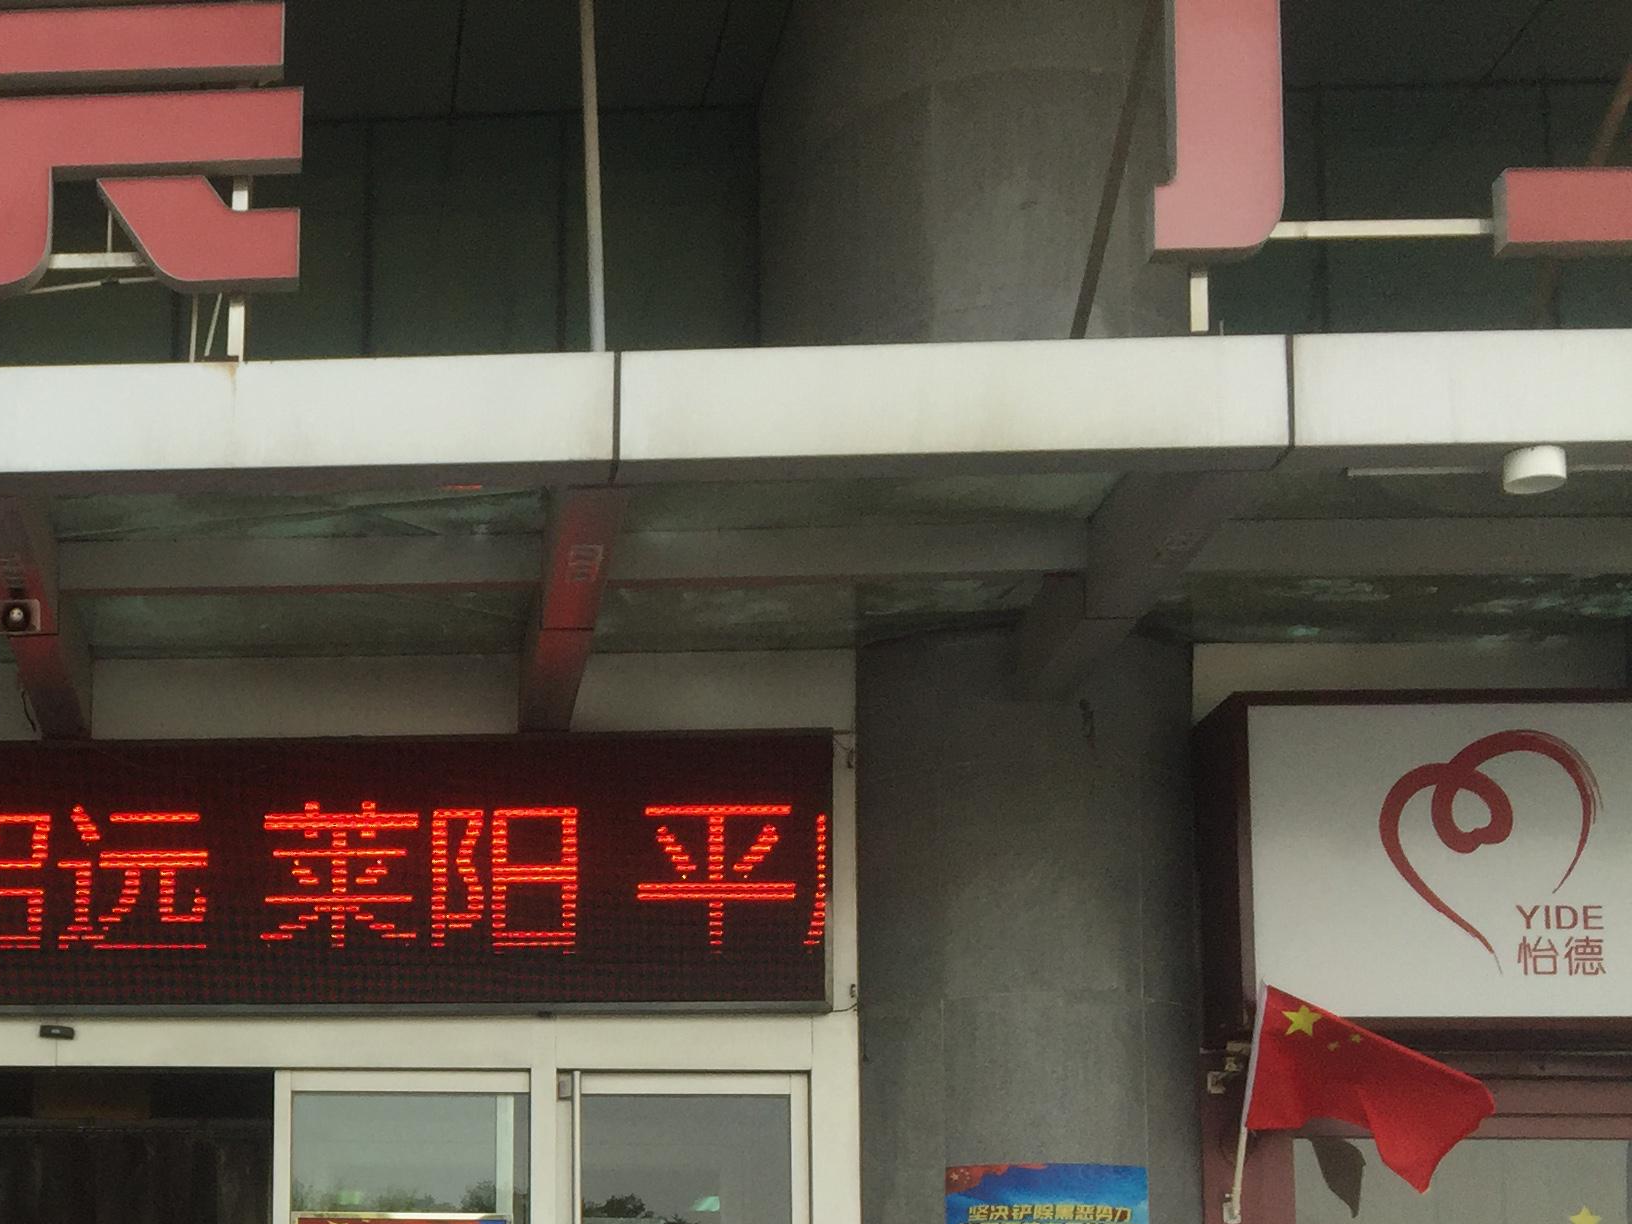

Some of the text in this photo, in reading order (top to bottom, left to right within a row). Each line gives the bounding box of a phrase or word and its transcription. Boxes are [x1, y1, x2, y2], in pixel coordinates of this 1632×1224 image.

[260, 800, 579, 954] 莱阳
[1515, 904, 1605, 931] YIDE
[1516, 935, 1607, 977] 怡德
